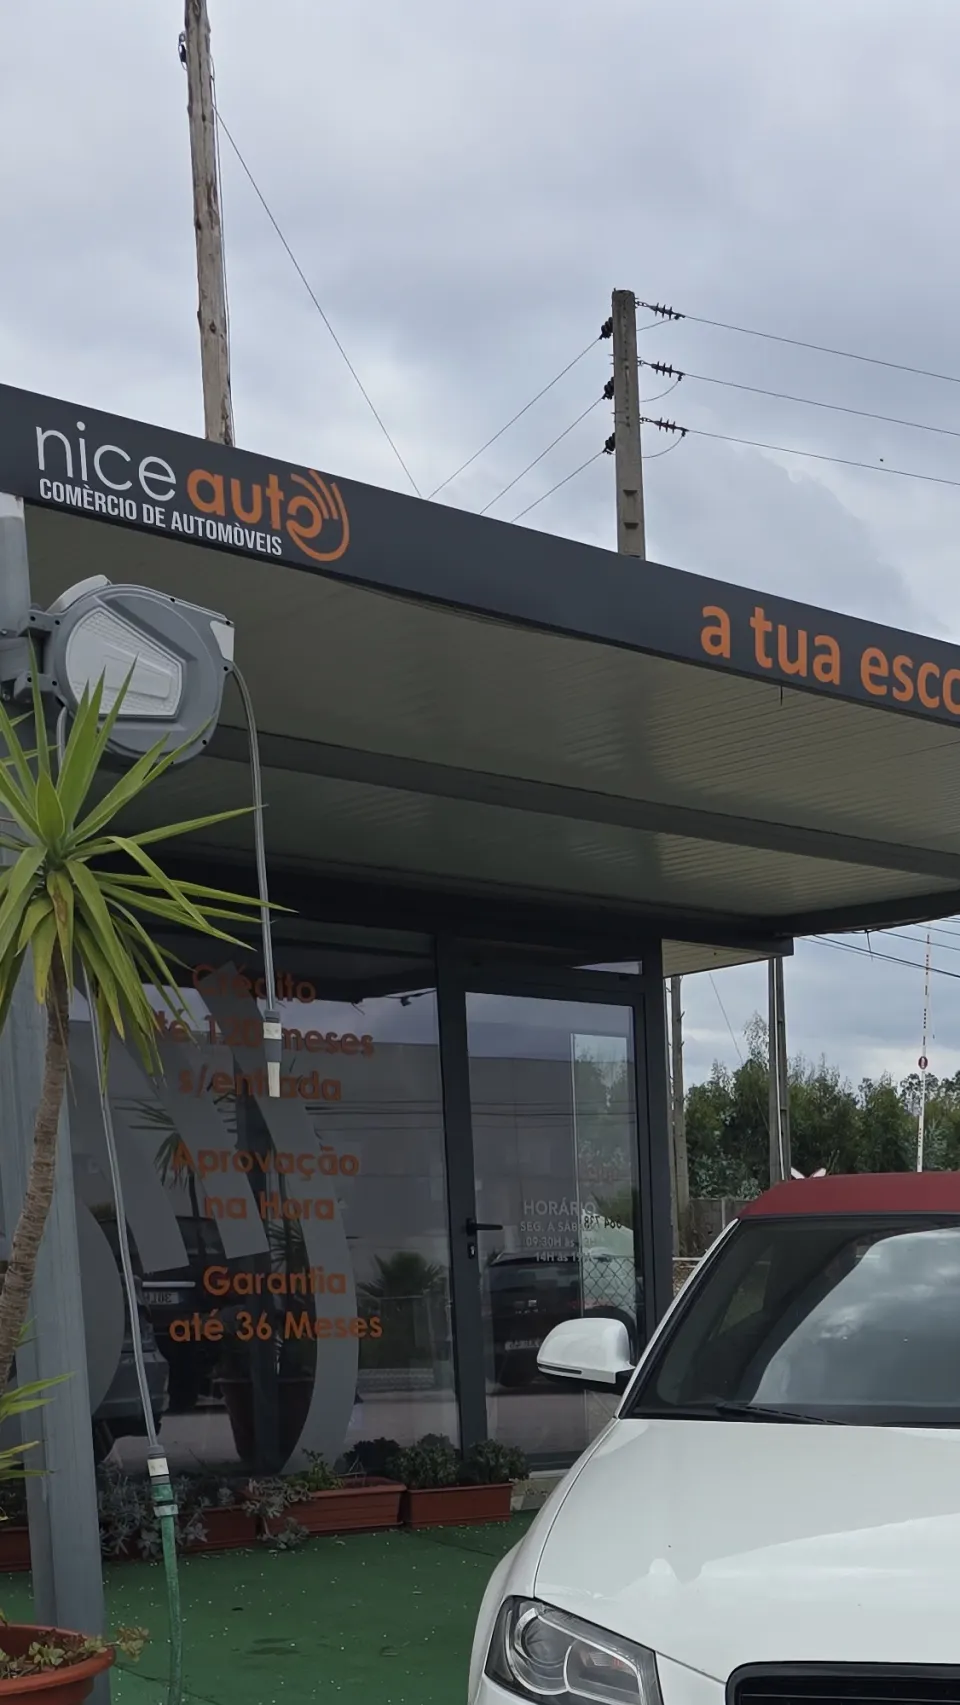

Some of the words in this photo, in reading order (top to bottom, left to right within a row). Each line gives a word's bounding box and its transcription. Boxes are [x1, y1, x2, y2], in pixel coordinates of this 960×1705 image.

[143, 503, 166, 528] DE
[701, 605, 731, 659] a
[750, 607, 841, 685] tua
[281, 1027, 375, 1057] meses
[171, 1141, 360, 1182] Aprovação
[204, 1197, 247, 1221] na
[259, 1190, 335, 1220] Hora
[203, 1265, 346, 1296] Garantia
[169, 1309, 224, 1342] até
[236, 1311, 272, 1340] 36
[285, 1311, 383, 1341] Meses
